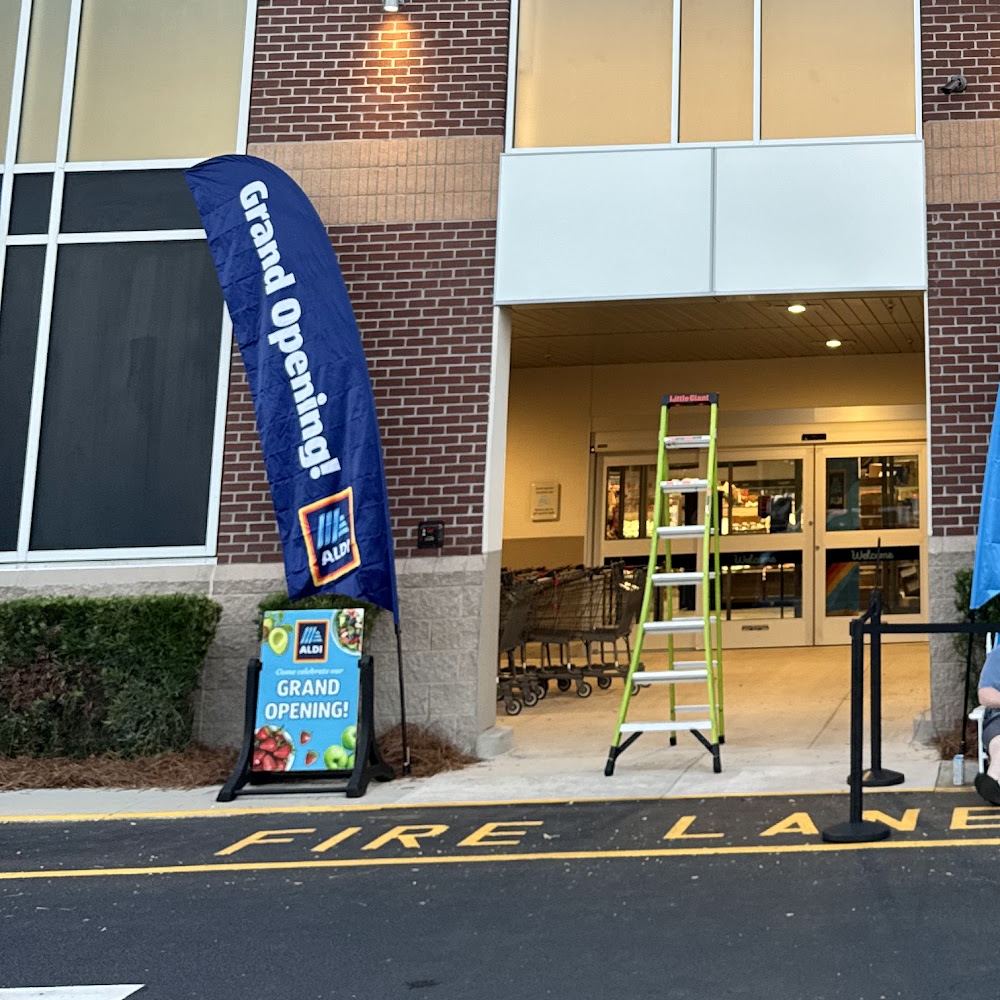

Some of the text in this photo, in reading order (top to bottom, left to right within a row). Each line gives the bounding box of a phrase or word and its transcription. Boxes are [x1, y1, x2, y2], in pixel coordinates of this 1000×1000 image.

[239, 180, 342, 480] Grand Opening!
[321, 539, 351, 566] ALDI
[299, 645, 323, 654] ALDI
[277, 678, 340, 697] GRAND
[265, 701, 349, 720] OPENING!
[214, 820, 544, 856] FIRE
